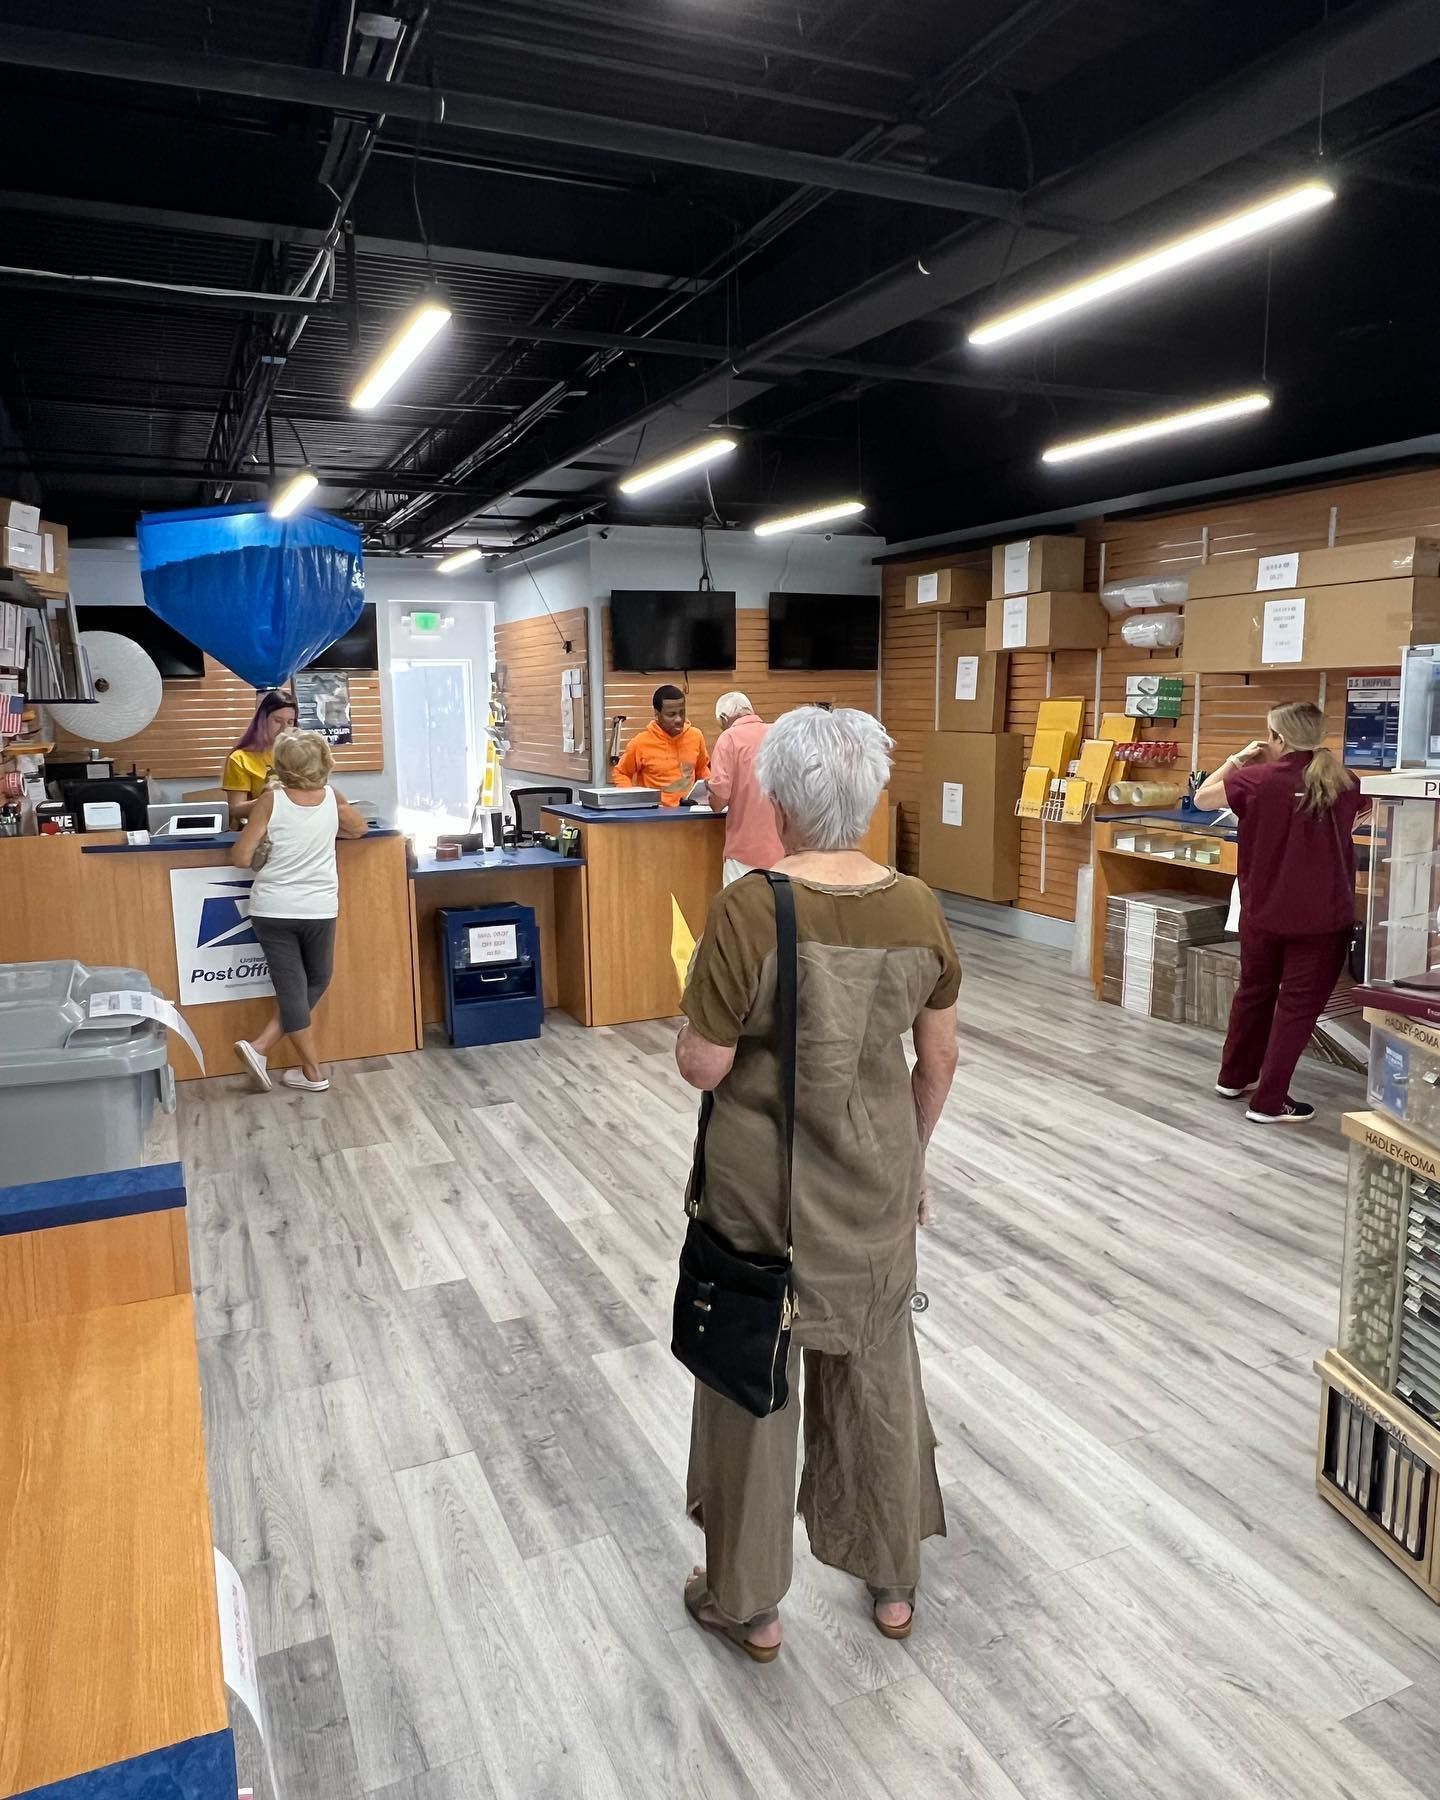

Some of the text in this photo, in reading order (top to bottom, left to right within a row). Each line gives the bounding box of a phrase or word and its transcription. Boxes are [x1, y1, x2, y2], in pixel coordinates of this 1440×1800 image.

[51, 816, 73, 828] WE
[191, 963, 270, 983] Post Offi
[1385, 1015, 1440, 1048] HADLEY-ROMA
[1365, 1130, 1437, 1177] HADLEY-ROMA
